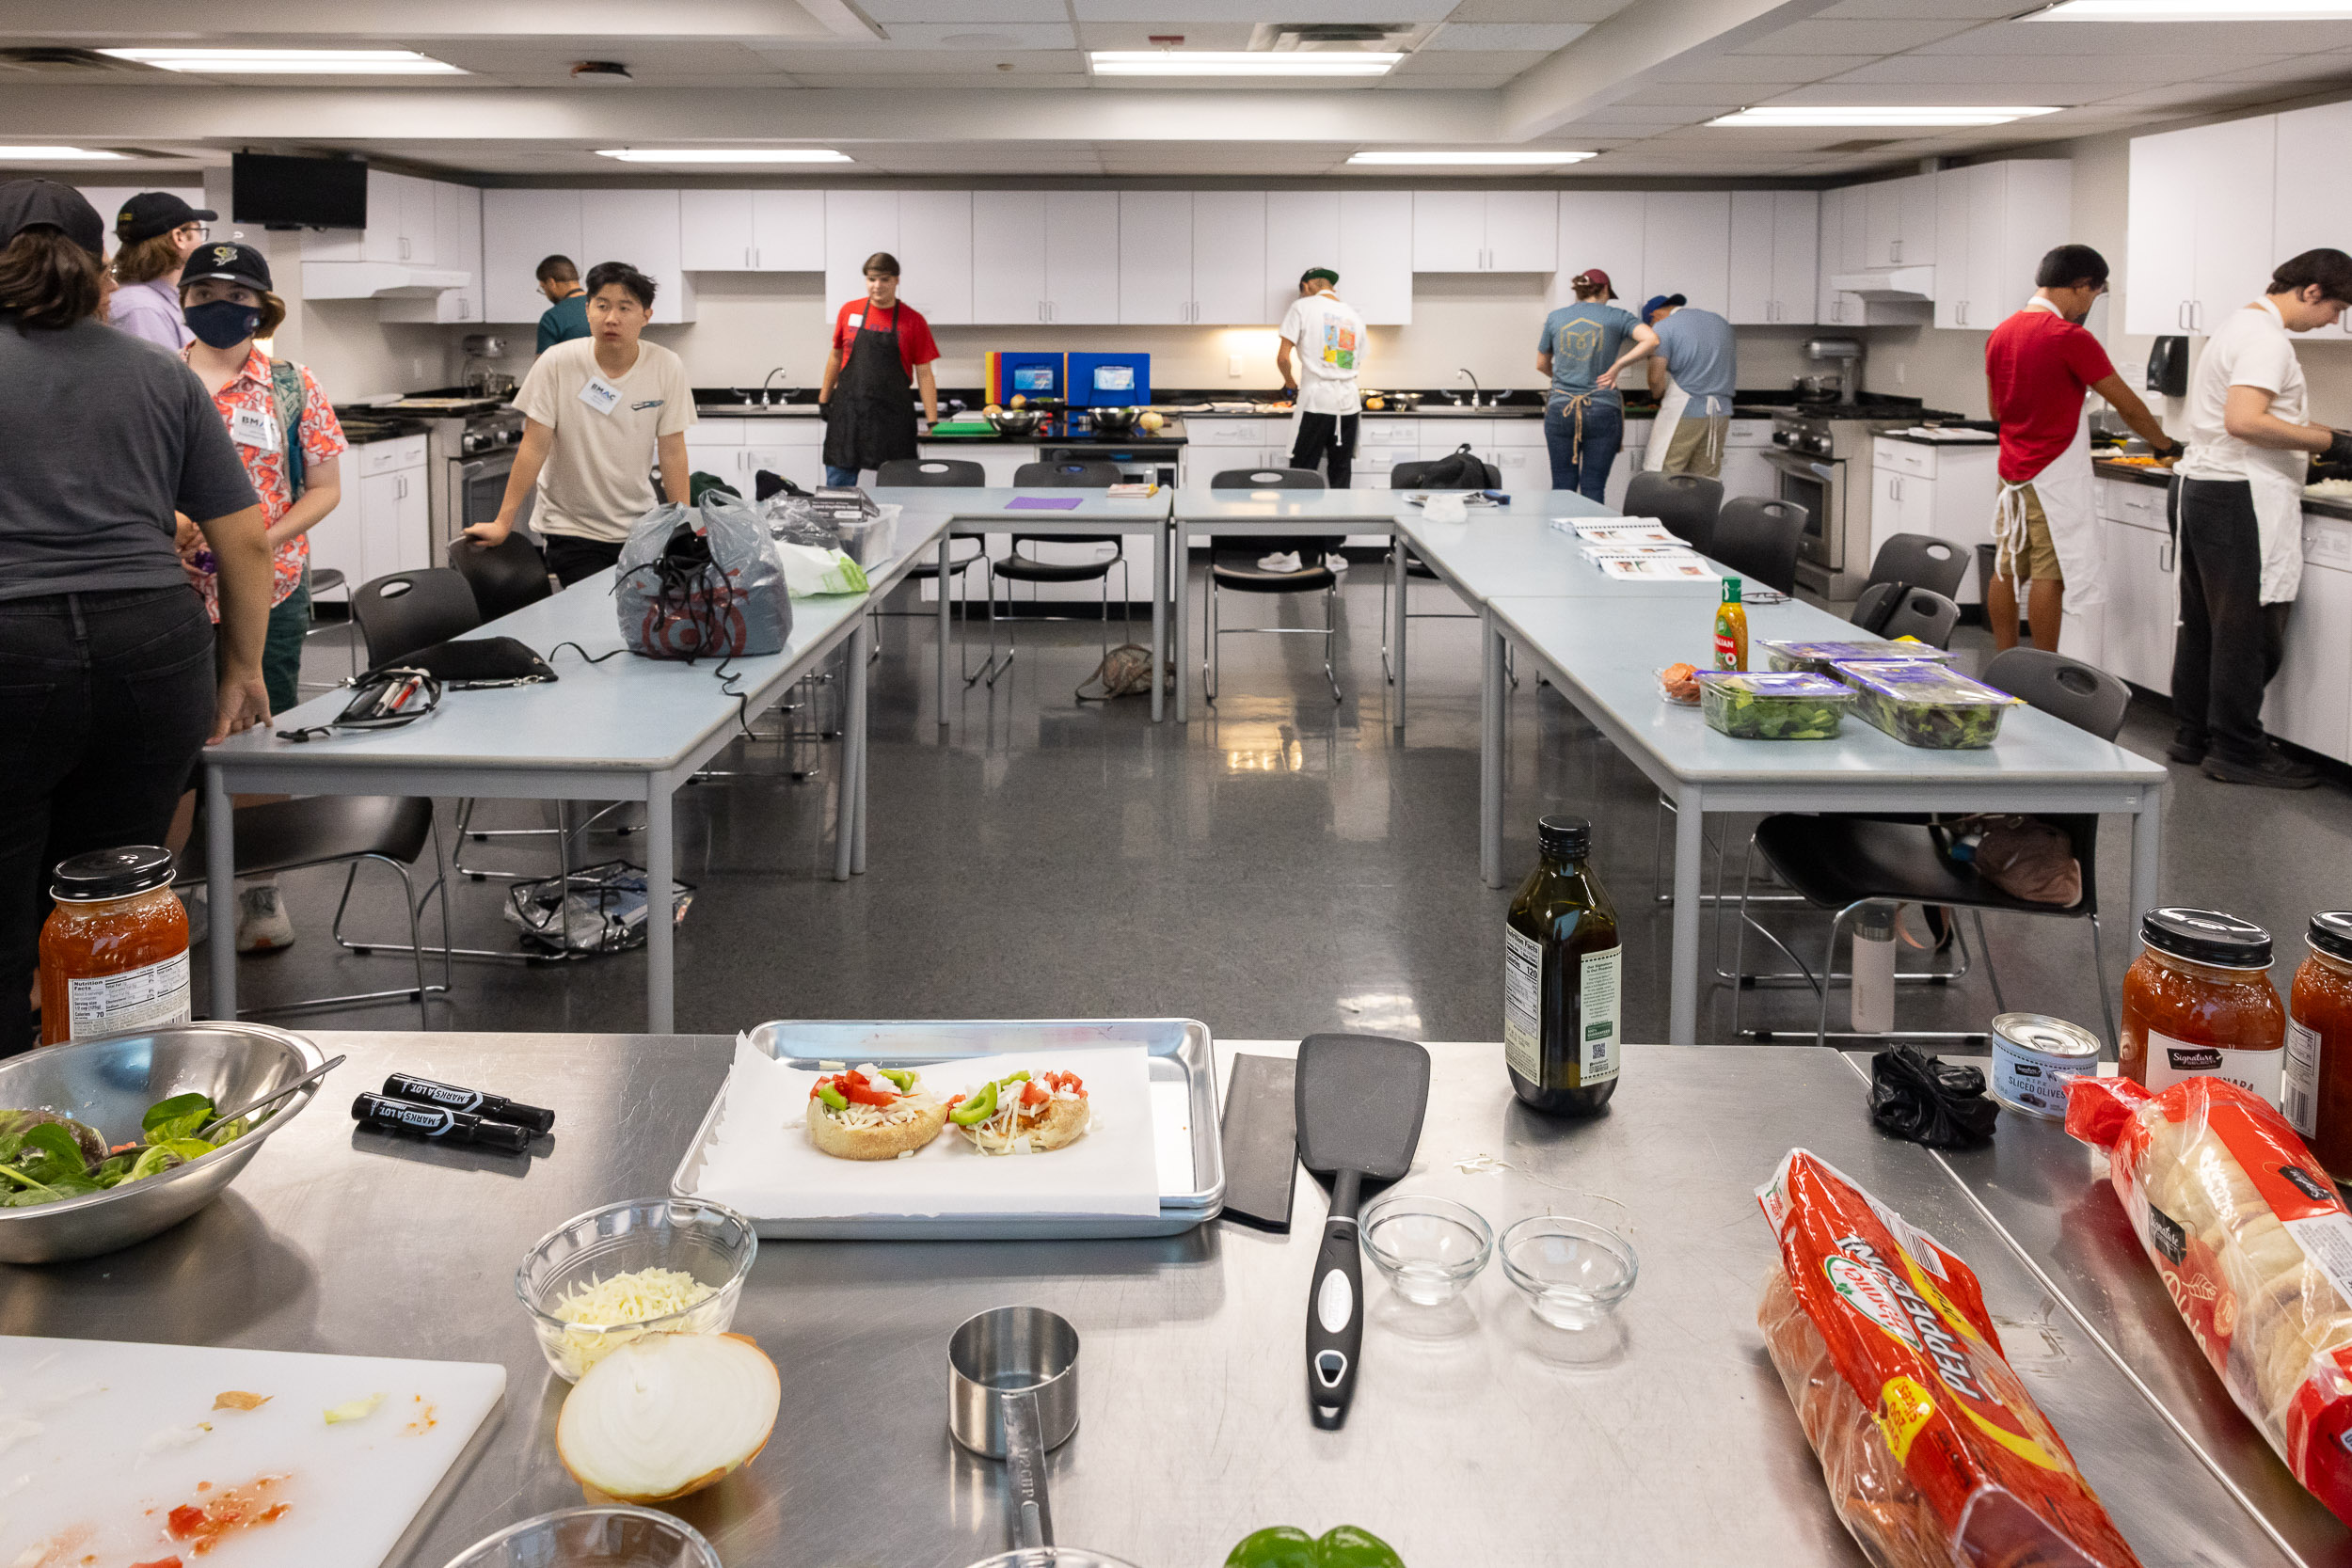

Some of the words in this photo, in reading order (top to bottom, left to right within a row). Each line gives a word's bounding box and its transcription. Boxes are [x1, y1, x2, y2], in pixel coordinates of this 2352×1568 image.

[1714, 636, 1734, 649] ALIAN
[1526, 966, 1538, 979] 120
[2173, 1053, 2213, 1065] Signature
[2009, 1076, 2035, 1092] SLICED
[2037, 1086, 2066, 1100] OLIVES
[434, 1089, 467, 1103] MARKS
[404, 1112, 438, 1127] MARKS
[1841, 1266, 1912, 1337] Hormel
[1834, 1233, 1982, 1402] PEPPERONI
